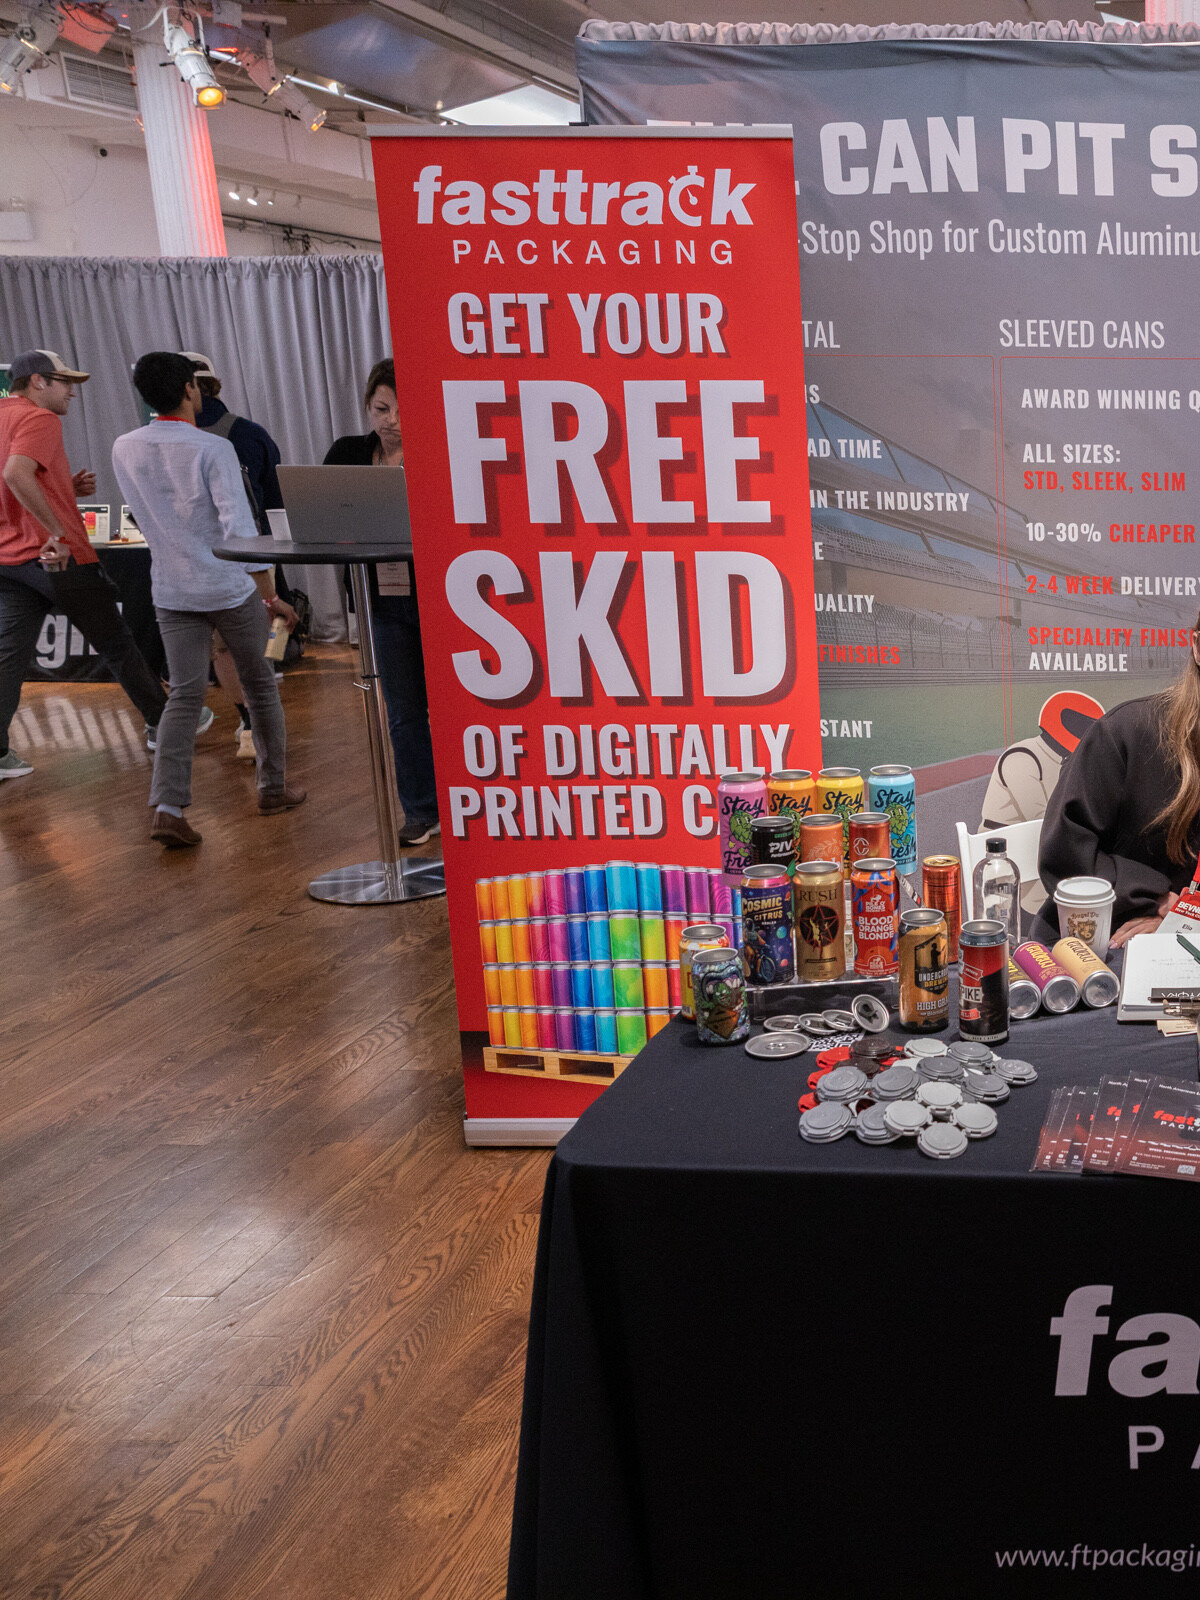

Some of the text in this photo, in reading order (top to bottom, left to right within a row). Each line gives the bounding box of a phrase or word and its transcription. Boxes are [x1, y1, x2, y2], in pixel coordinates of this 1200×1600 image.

[819, 116, 980, 196] CAN
[1002, 117, 1125, 196] PIT
[413, 165, 757, 227] fasttrack
[870, 218, 933, 261] Shop
[943, 219, 979, 254] for
[988, 218, 1087, 256] Custom
[452, 239, 733, 264] PACKAGING
[447, 292, 726, 354] GET YOUR
[1000, 320, 1165, 350] SLEEVED CANS
[1022, 388, 1089, 409] AWARD
[1097, 390, 1181, 410] WINNING
[442, 380, 771, 524] FREE
[808, 438, 882, 458] AD TIME
[1023, 444, 1121, 464] ALL SIZES:
[1024, 471, 1186, 494] STD, SLEEK, SLIM
[835, 490, 869, 510] THE
[876, 492, 970, 512] INDUSTRY
[1026, 522, 1196, 544] 10-30% CHEAPER
[1026, 575, 1058, 595] 2-4
[1066, 576, 1114, 595] WEEK
[814, 593, 874, 614] UALITY
[445, 550, 787, 700] SKID
[1028, 626, 1194, 648] SPECIALITY FINIS
[820, 644, 901, 665] FINISHES
[1029, 653, 1128, 672] AVAILABLE
[462, 724, 791, 777] OF DIGITALLY
[722, 796, 765, 819] Stay
[770, 793, 812, 817] Stay
[823, 791, 863, 814] Stay
[874, 789, 914, 810] Stay
[449, 786, 663, 837] PRINTED
[742, 897, 782, 914] COSMIC
[800, 889, 838, 901] RUSH
[754, 910, 783, 921] CITRUS
[859, 916, 893, 925] BLOOD
[859, 924, 893, 932] ORANGE
[859, 931, 894, 940] BLONDE
[917, 1002, 936, 1011] HIGH
